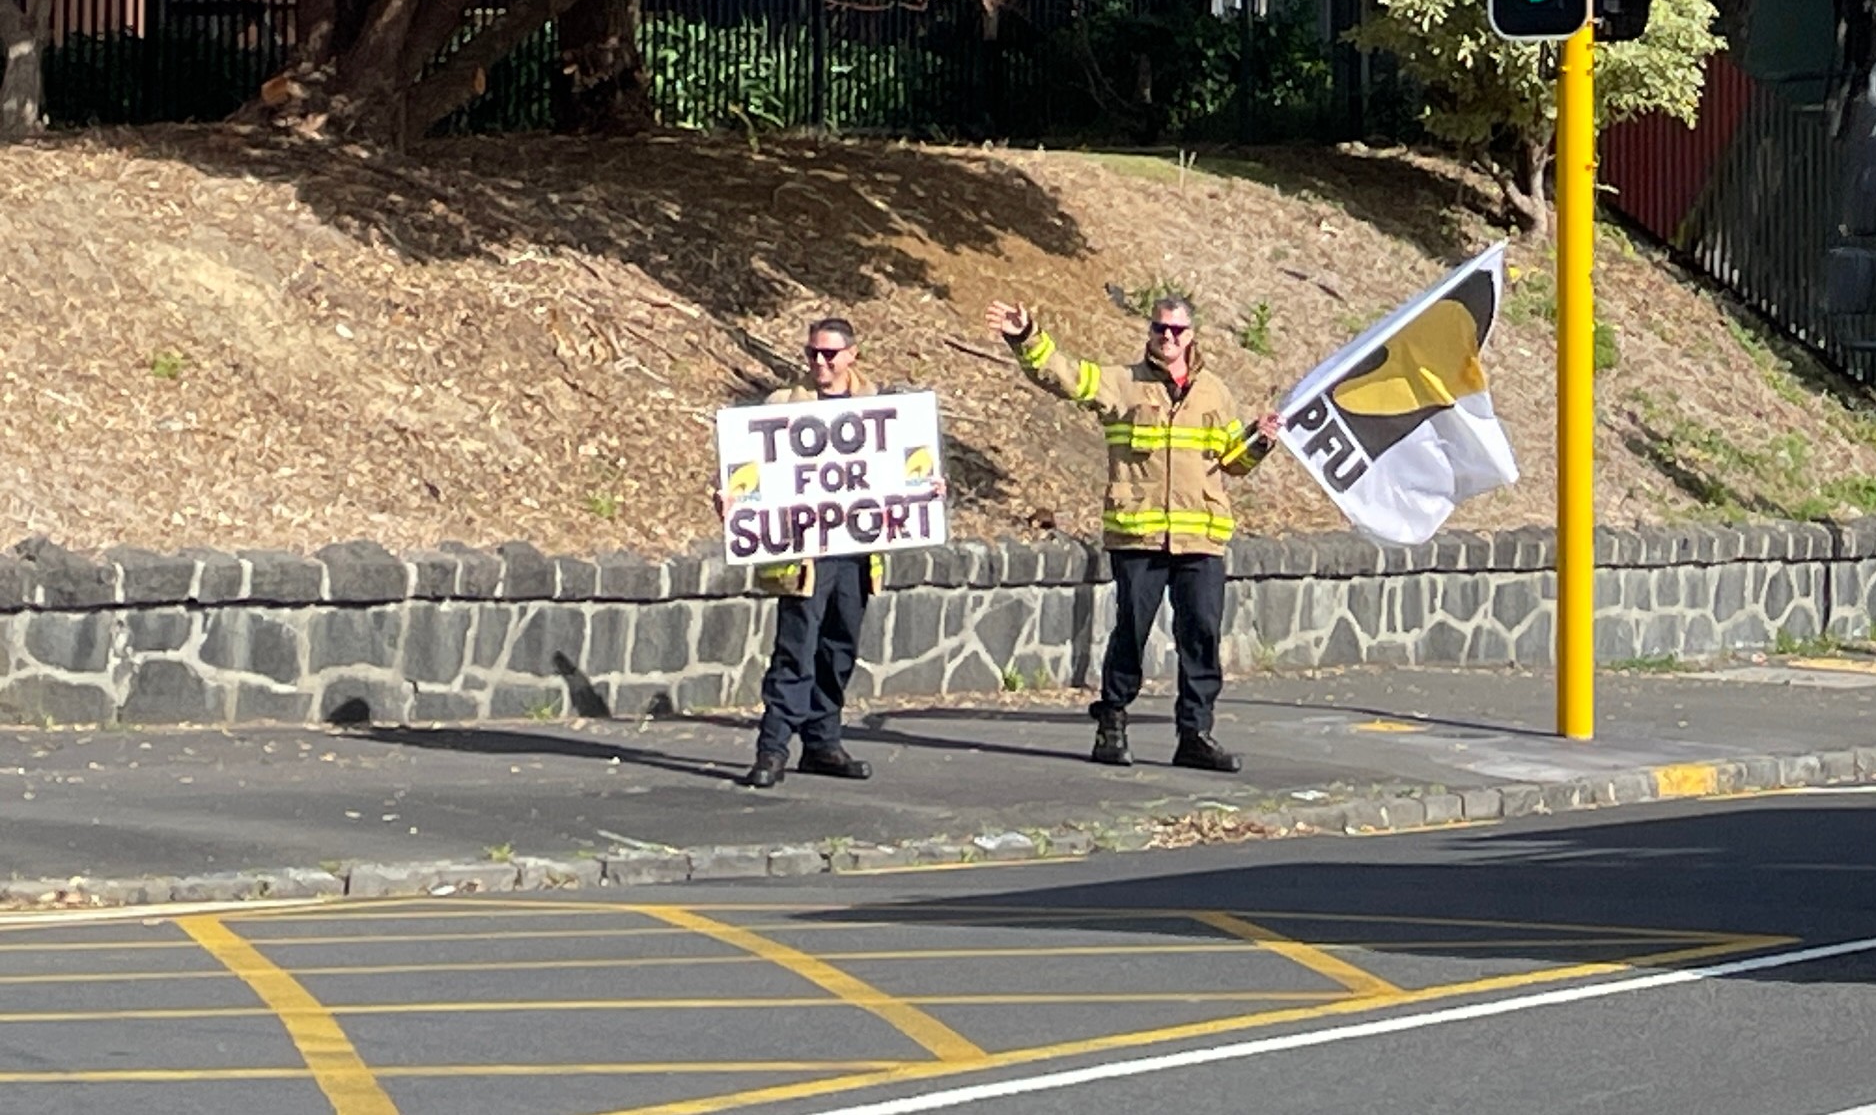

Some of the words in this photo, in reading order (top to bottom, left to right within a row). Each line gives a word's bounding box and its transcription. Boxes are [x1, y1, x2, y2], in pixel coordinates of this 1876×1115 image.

[748, 408, 898, 463] TOOT
[1286, 395, 1369, 494] PFU
[794, 460, 871, 495] FOR
[729, 488, 938, 558] SUPPORT
